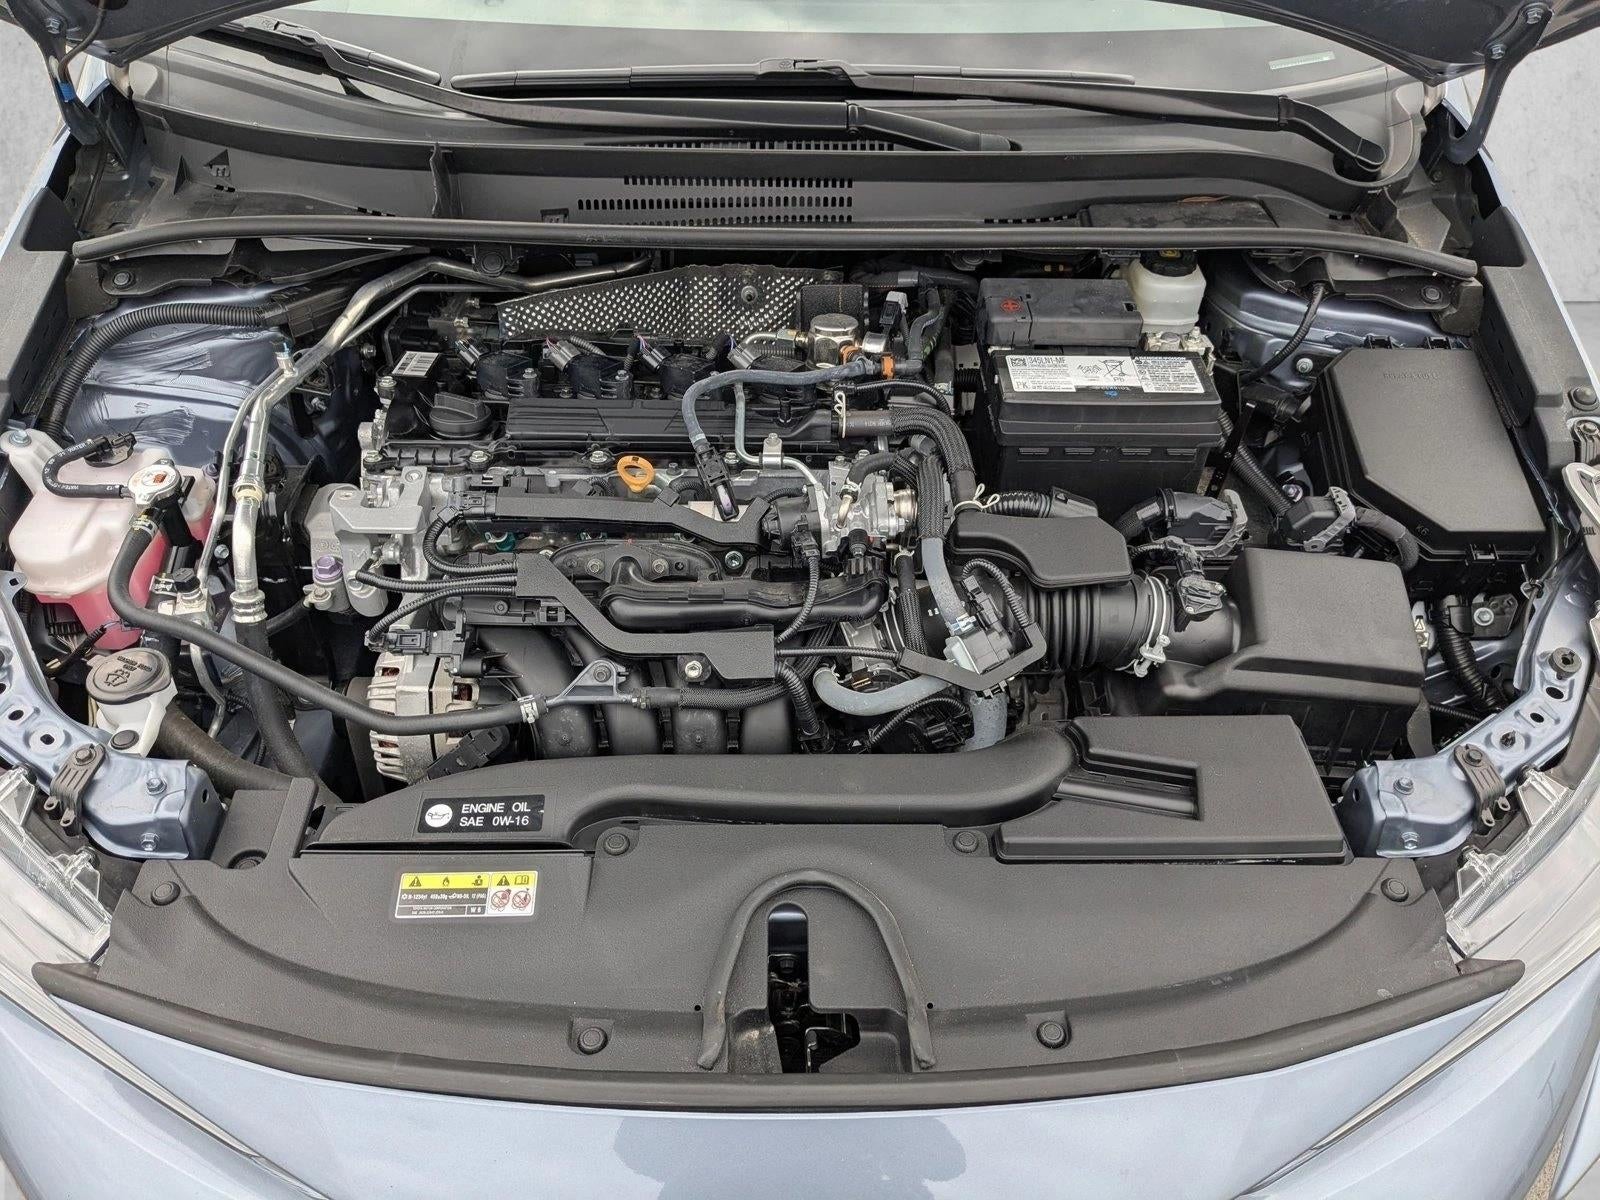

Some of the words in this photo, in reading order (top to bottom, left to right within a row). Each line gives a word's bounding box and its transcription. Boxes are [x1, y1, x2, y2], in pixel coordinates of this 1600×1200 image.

[461, 802, 505, 814] ENGINE
[511, 802, 531, 813] OIL
[459, 816, 484, 827] SAE
[492, 815, 530, 826] 0W-16
